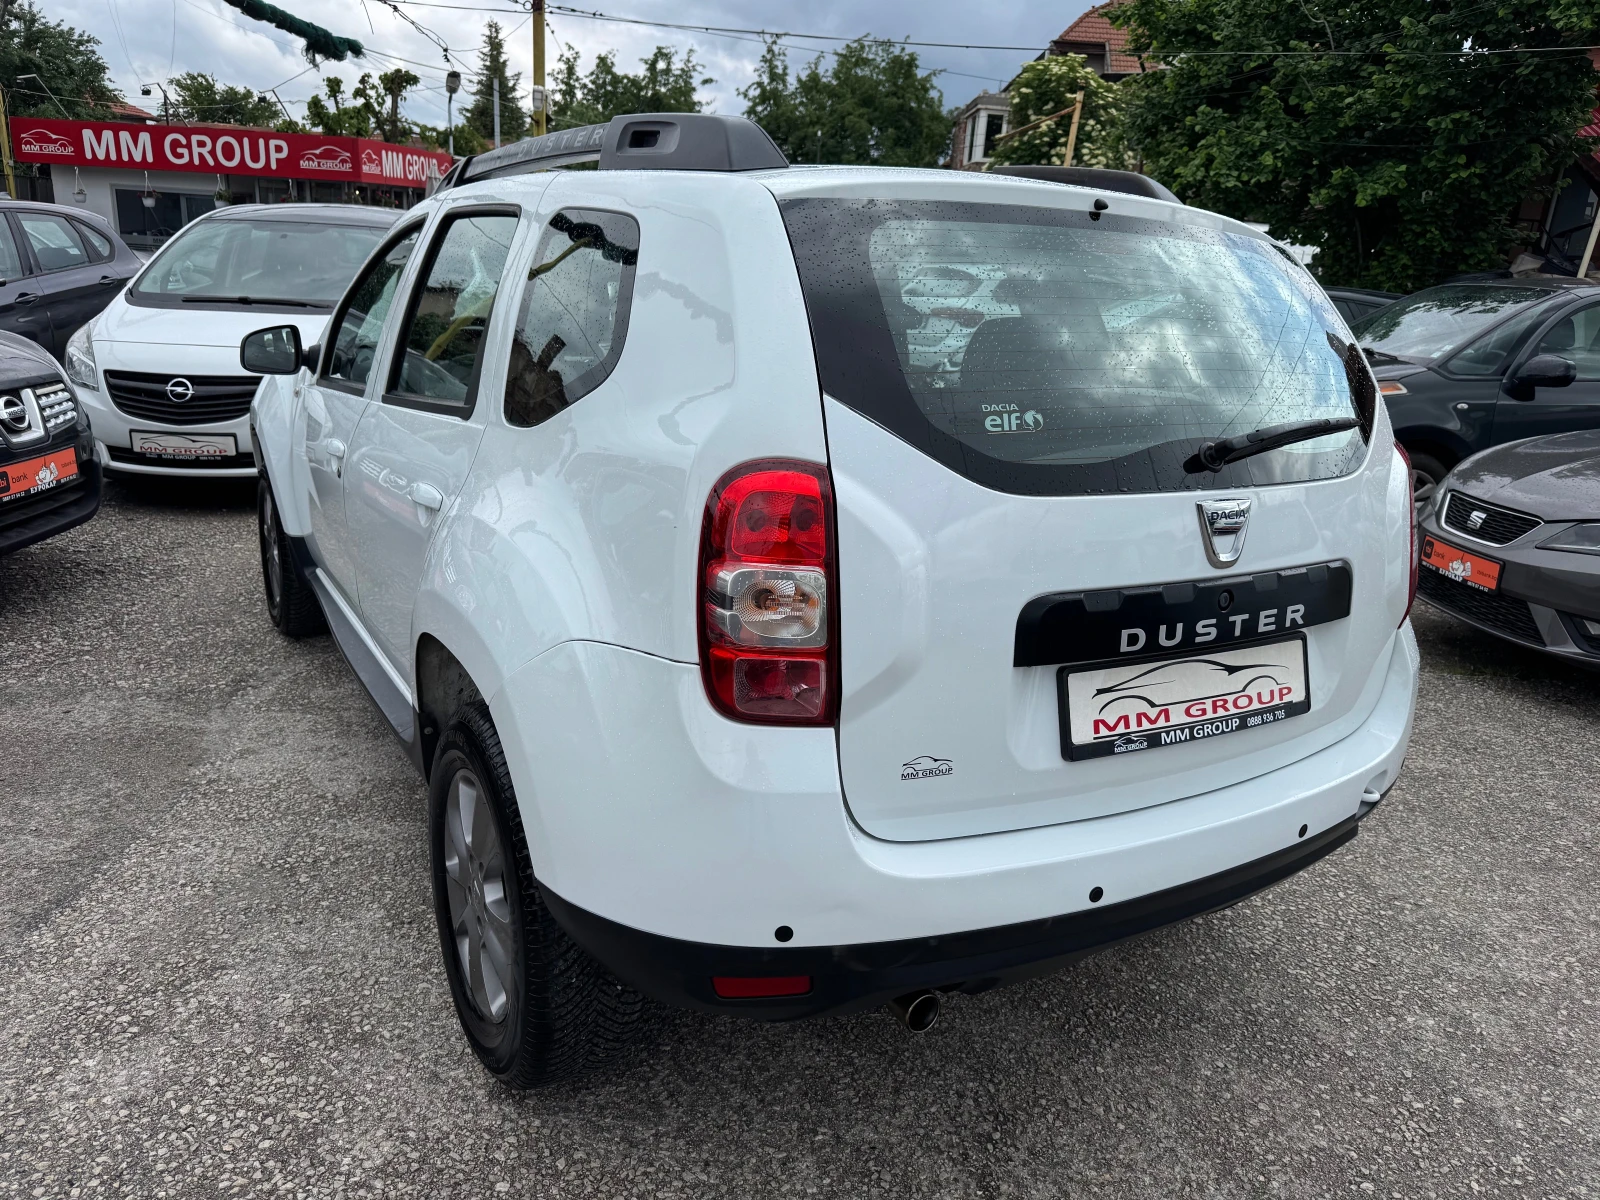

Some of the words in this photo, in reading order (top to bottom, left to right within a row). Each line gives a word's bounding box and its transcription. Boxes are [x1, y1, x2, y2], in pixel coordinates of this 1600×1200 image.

[21, 144, 40, 152] MM
[42, 145, 74, 154] GROUP
[81, 128, 154, 163] MM
[163, 132, 289, 171] GROUP
[517, 129, 603, 158] DUSTER
[299, 160, 319, 168] MM
[320, 161, 353, 170] GROUP
[381, 149, 404, 180] MM
[982, 404, 1019, 412] DACIA
[985, 413, 1020, 431] elf
[139, 445, 168, 453] MM
[11, 472, 29, 484] bank
[1210, 509, 1246, 521] DACIA
[1119, 603, 1306, 653] DUSTER
[1093, 707, 1172, 735] MM
[1184, 685, 1293, 718] GROUP
[1160, 727, 1191, 745] MM
[1192, 718, 1241, 739] GROUP
[1246, 714, 1263, 727] 0888
[1262, 711, 1275, 724] 936
[1274, 708, 1286, 721] 705
[901, 771, 919, 779] MM
[921, 767, 953, 777] GROUP
